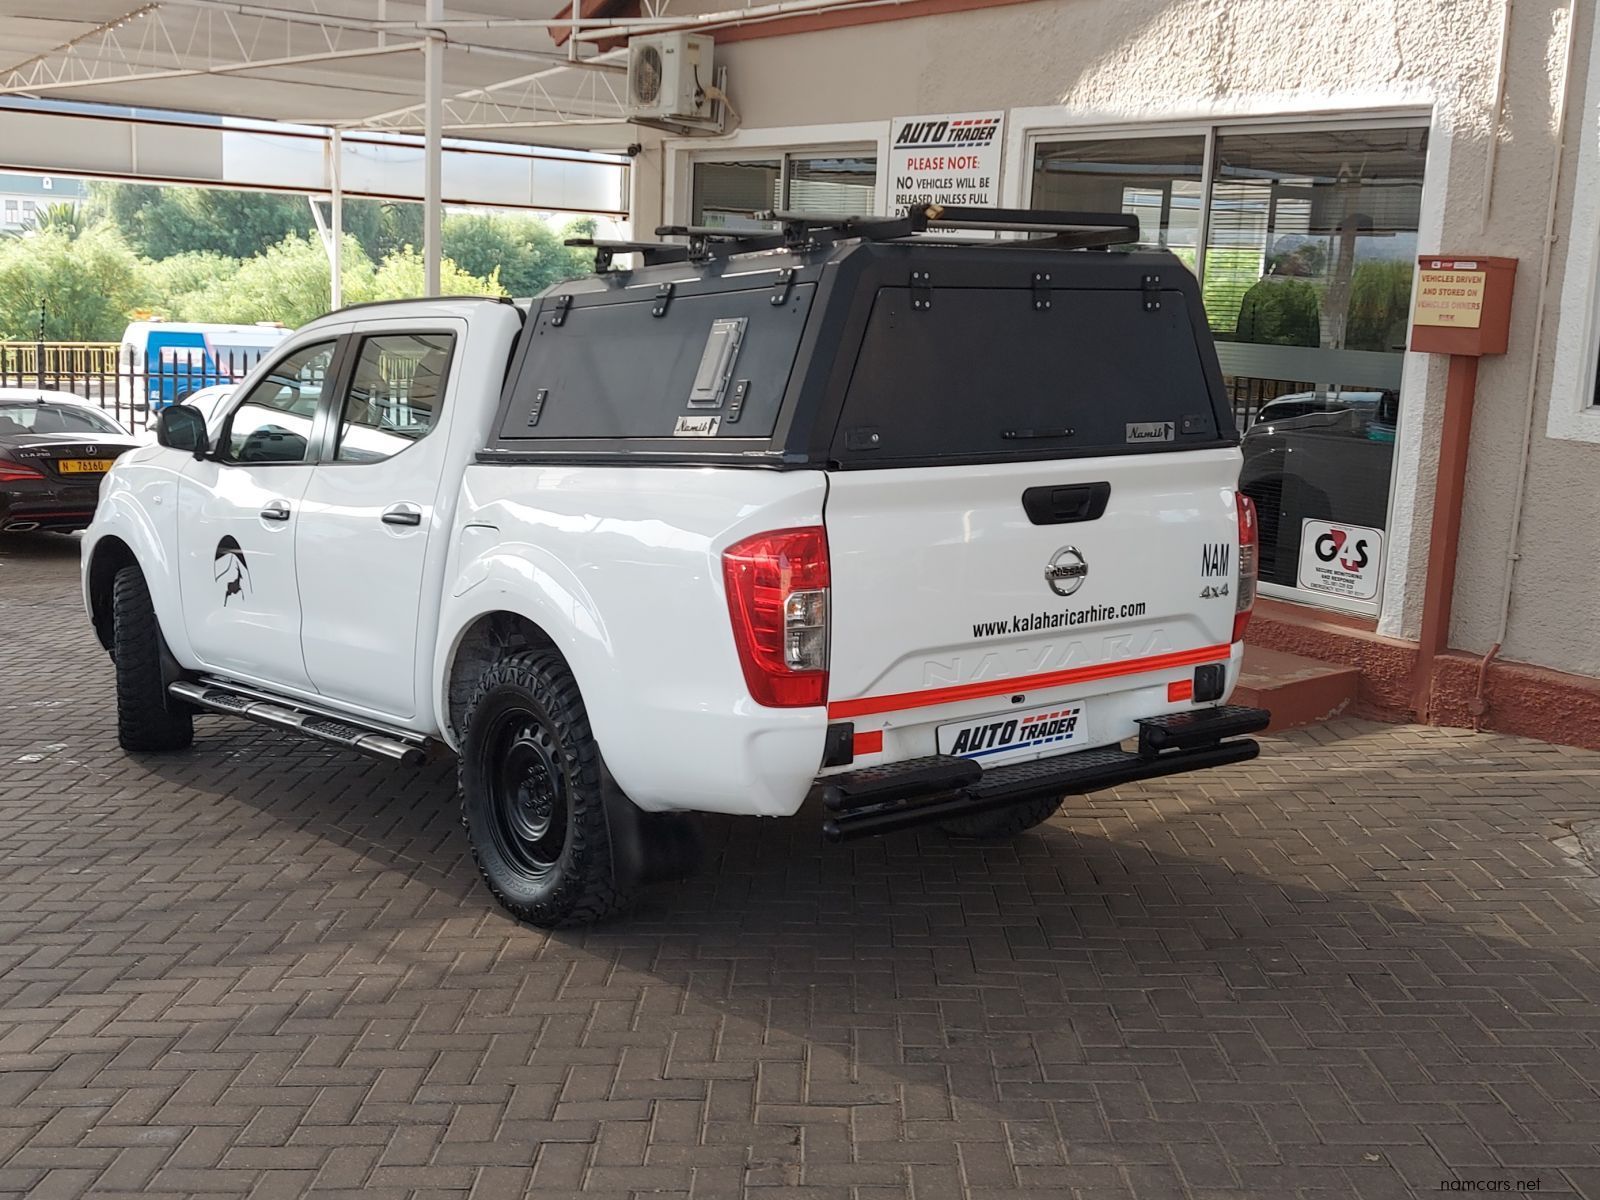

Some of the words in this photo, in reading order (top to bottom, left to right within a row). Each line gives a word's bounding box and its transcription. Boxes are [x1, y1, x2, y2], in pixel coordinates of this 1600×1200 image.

[896, 121, 949, 144] AUTO
[947, 126, 997, 142] TRADER
[907, 157, 944, 171] PLEASE
[947, 156, 980, 170] NOTE:
[896, 176, 914, 190] NO
[916, 177, 953, 189] VEHICLES
[956, 177, 976, 188] WILL
[979, 177, 990, 188] BE
[895, 194, 932, 205] RELEASED
[934, 194, 967, 204] UNLESS
[969, 193, 989, 204] FULL
[1422, 275, 1454, 283] VEHICLES
[1455, 276, 1482, 284] DRIVEN
[1422, 288, 1437, 296] AND
[1438, 288, 1466, 296] STORED
[1466, 289, 1477, 297] ON
[676, 418, 708, 432] Namib
[1128, 426, 1163, 439] Namib
[62, 462, 69, 471] N
[1315, 529, 1368, 572] G4S
[1201, 544, 1230, 577] NAM
[1050, 565, 1087, 577] NISSAN
[1199, 583, 1230, 599] 4x4
[972, 601, 1146, 638] www.kalaharicarhire.com
[922, 628, 1174, 687] NAVARA
[951, 720, 1018, 755] AUTO
[1019, 717, 1078, 741] TRADER
